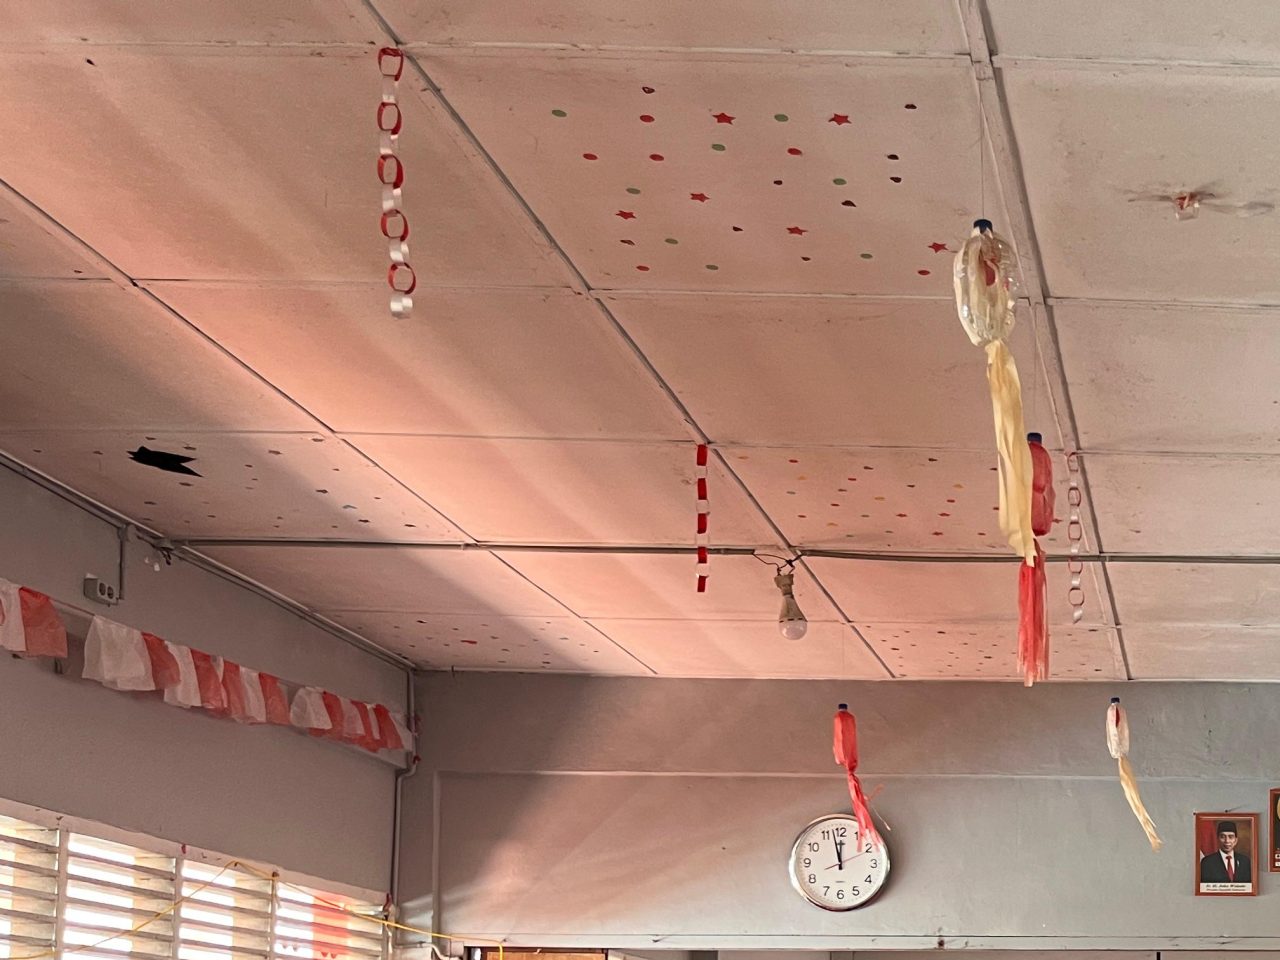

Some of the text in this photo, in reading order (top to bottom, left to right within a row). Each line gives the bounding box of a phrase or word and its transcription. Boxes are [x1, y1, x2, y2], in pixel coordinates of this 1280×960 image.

[822, 830, 830, 841] 11
[836, 827, 847, 838] 12
[808, 842, 819, 853] 10
[865, 842, 873, 853] 2
[803, 858, 812, 868] 9
[870, 858, 878, 869] 3
[808, 873, 817, 884] 8
[864, 874, 872, 884] 4
[823, 886, 830, 896] 7
[836, 889, 845, 900] 6
[852, 886, 860, 896] 5
